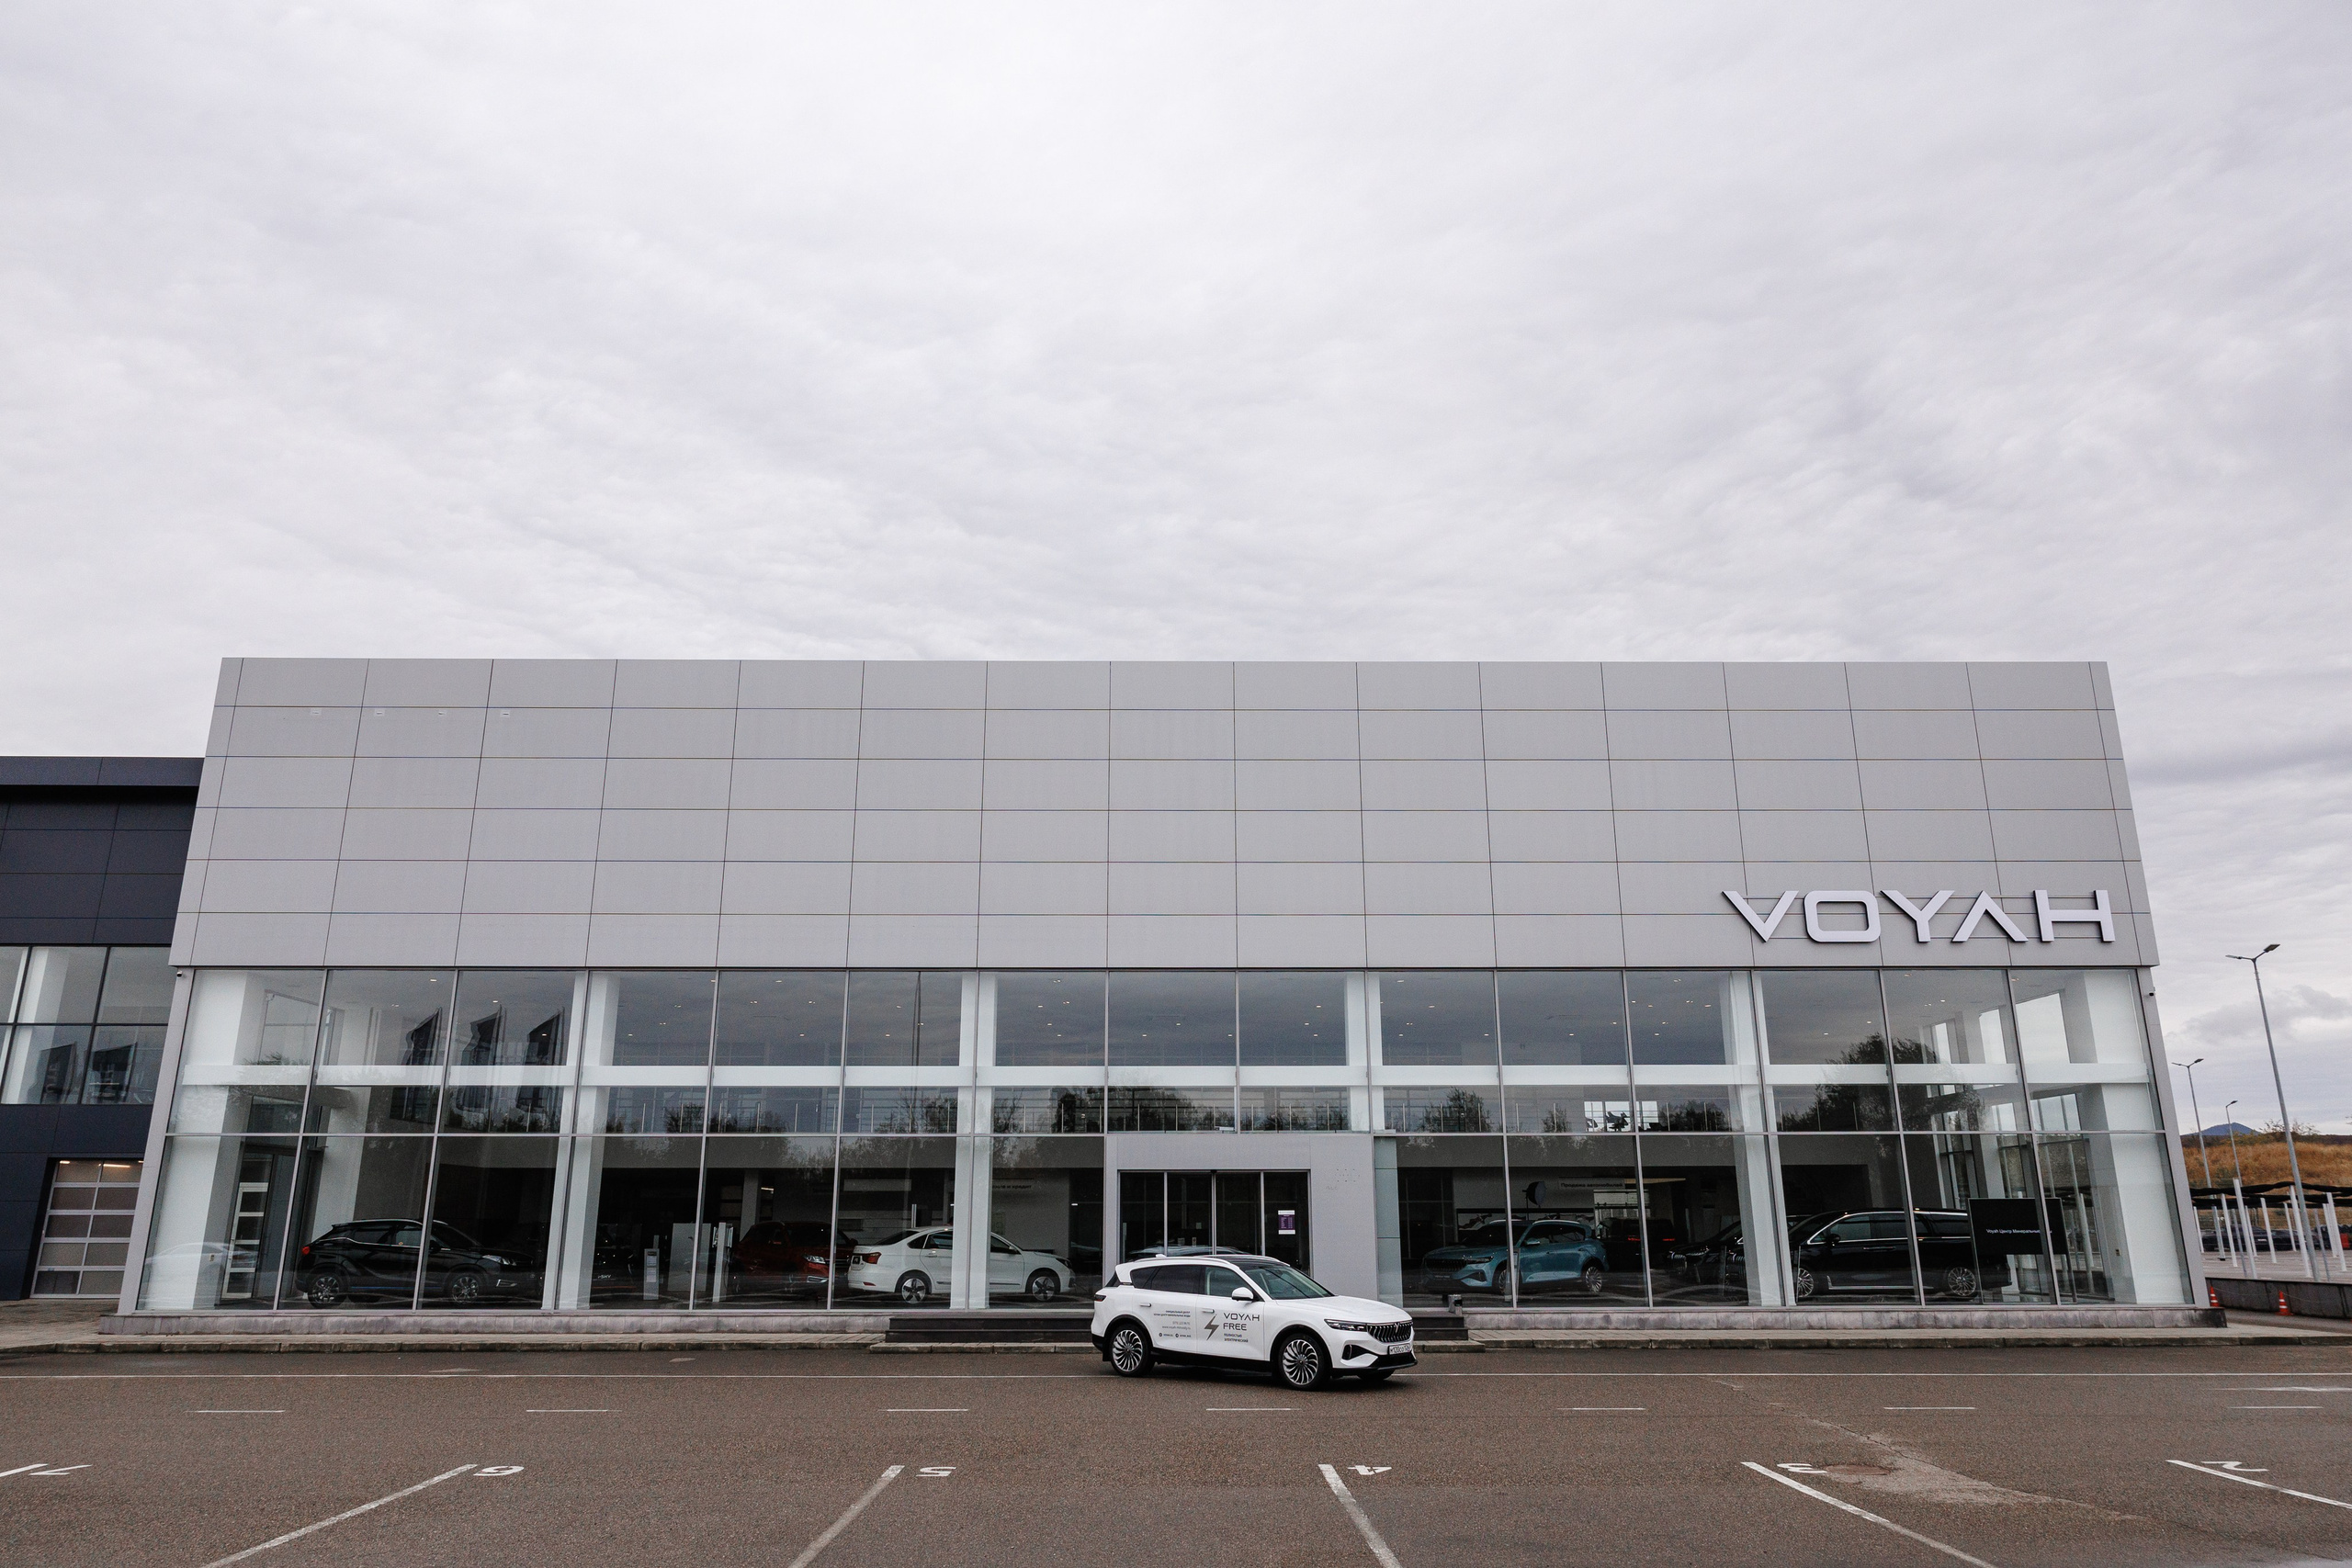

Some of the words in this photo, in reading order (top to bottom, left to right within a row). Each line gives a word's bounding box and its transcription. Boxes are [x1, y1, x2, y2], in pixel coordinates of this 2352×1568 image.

[1722, 889, 2116, 942] VOYAH
[1223, 1313, 1260, 1321] VOYAH
[1223, 1323, 1248, 1331] FREE
